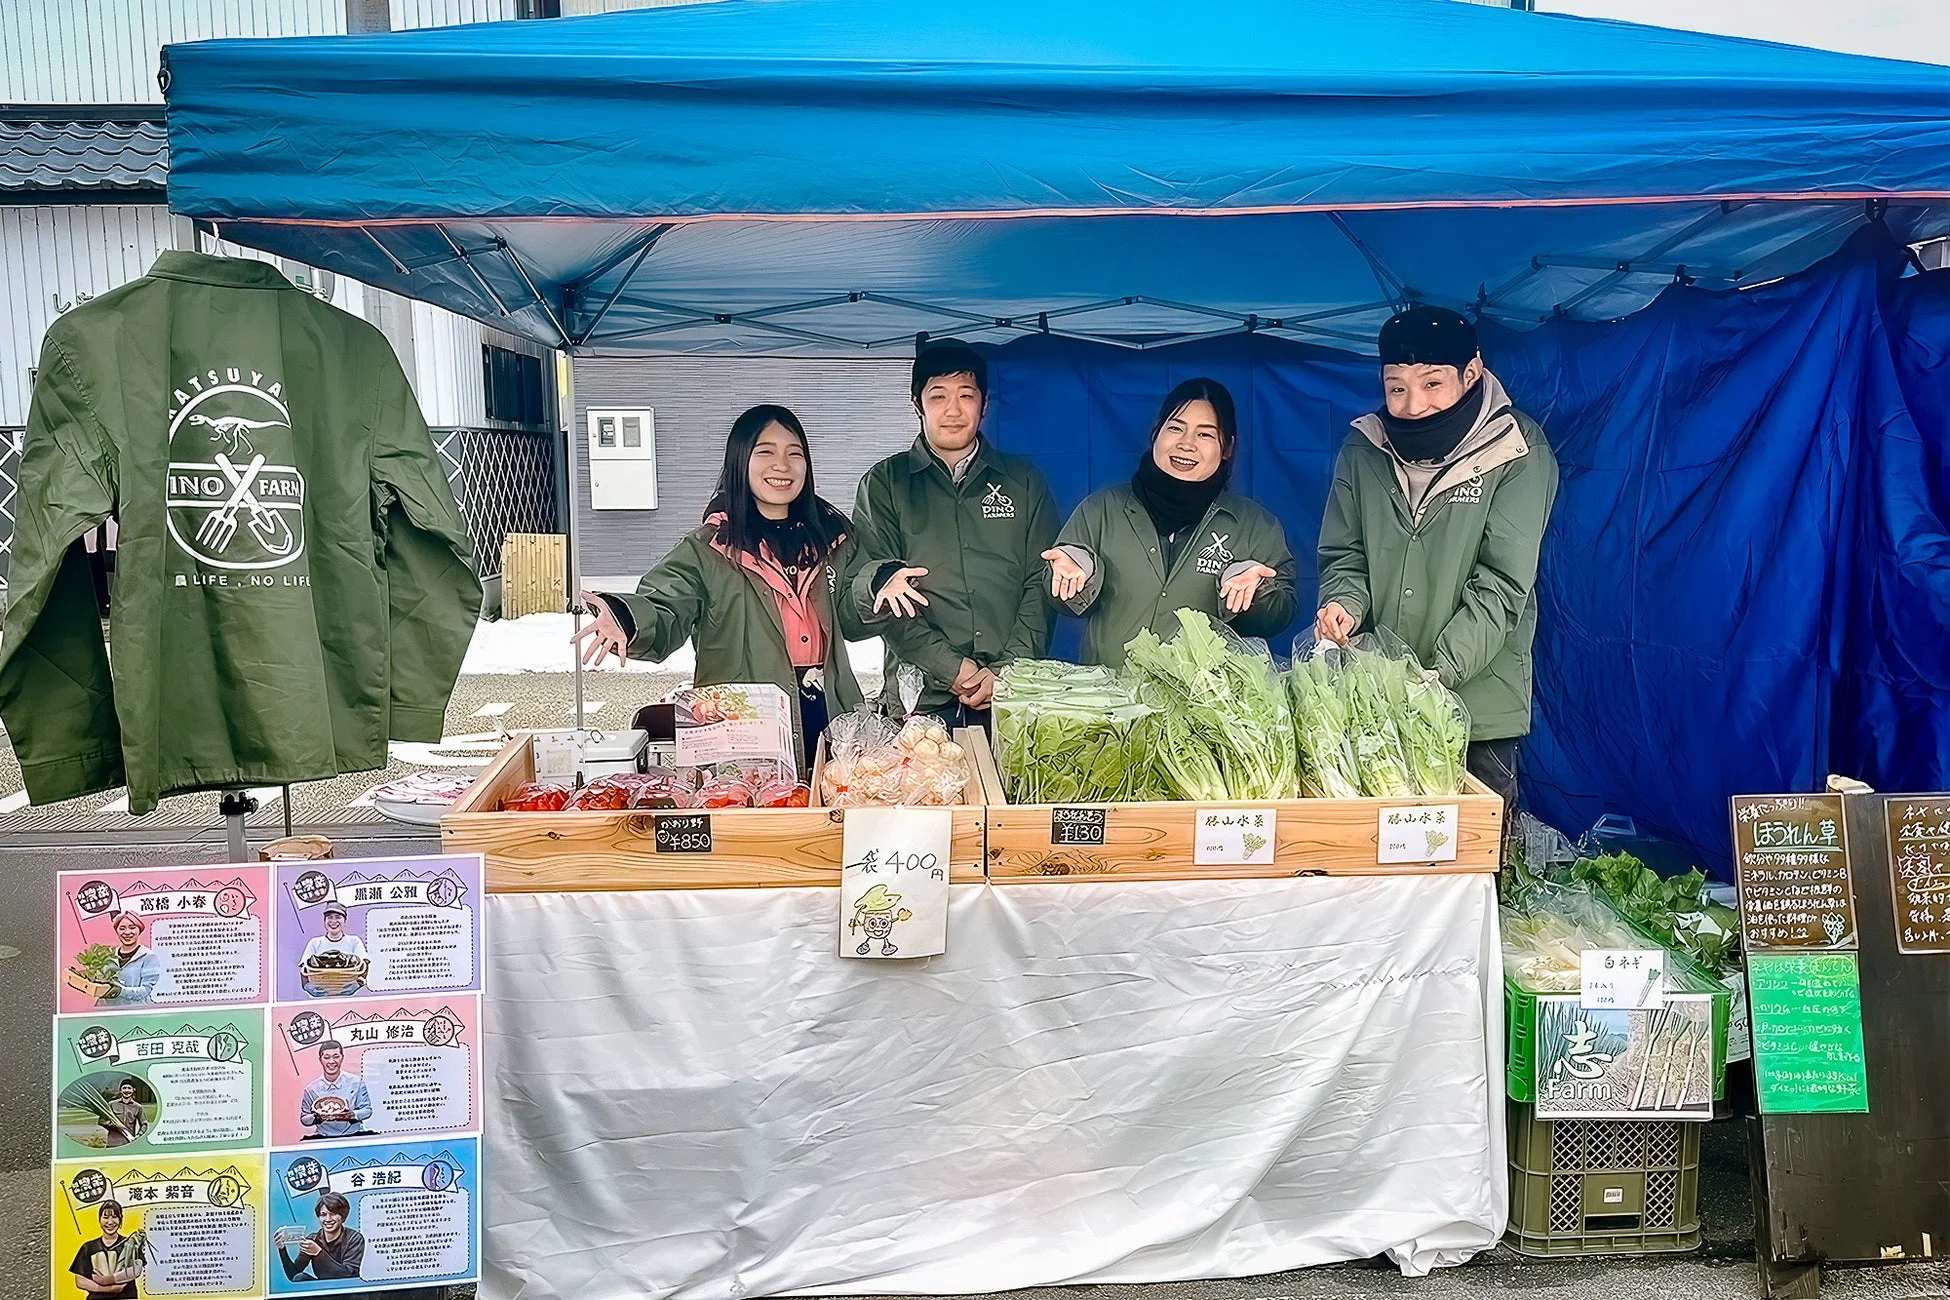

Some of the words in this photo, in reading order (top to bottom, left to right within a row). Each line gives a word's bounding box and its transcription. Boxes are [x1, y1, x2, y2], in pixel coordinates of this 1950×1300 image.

[169, 367, 289, 420] ATSUYA
[982, 505, 1015, 513] DINO
[1196, 557, 1228, 570] DIN
[251, 575, 275, 587] NO
[1753, 819, 1838, 847] ほうれん草
[669, 833, 711, 850] ¥850
[350, 1027, 378, 1042] 丸山
[136, 1042, 164, 1056] 吉田
[1553, 1020, 1614, 1079] 志
[1549, 1078, 1614, 1100] Farm
[350, 1172, 366, 1187] 谷
